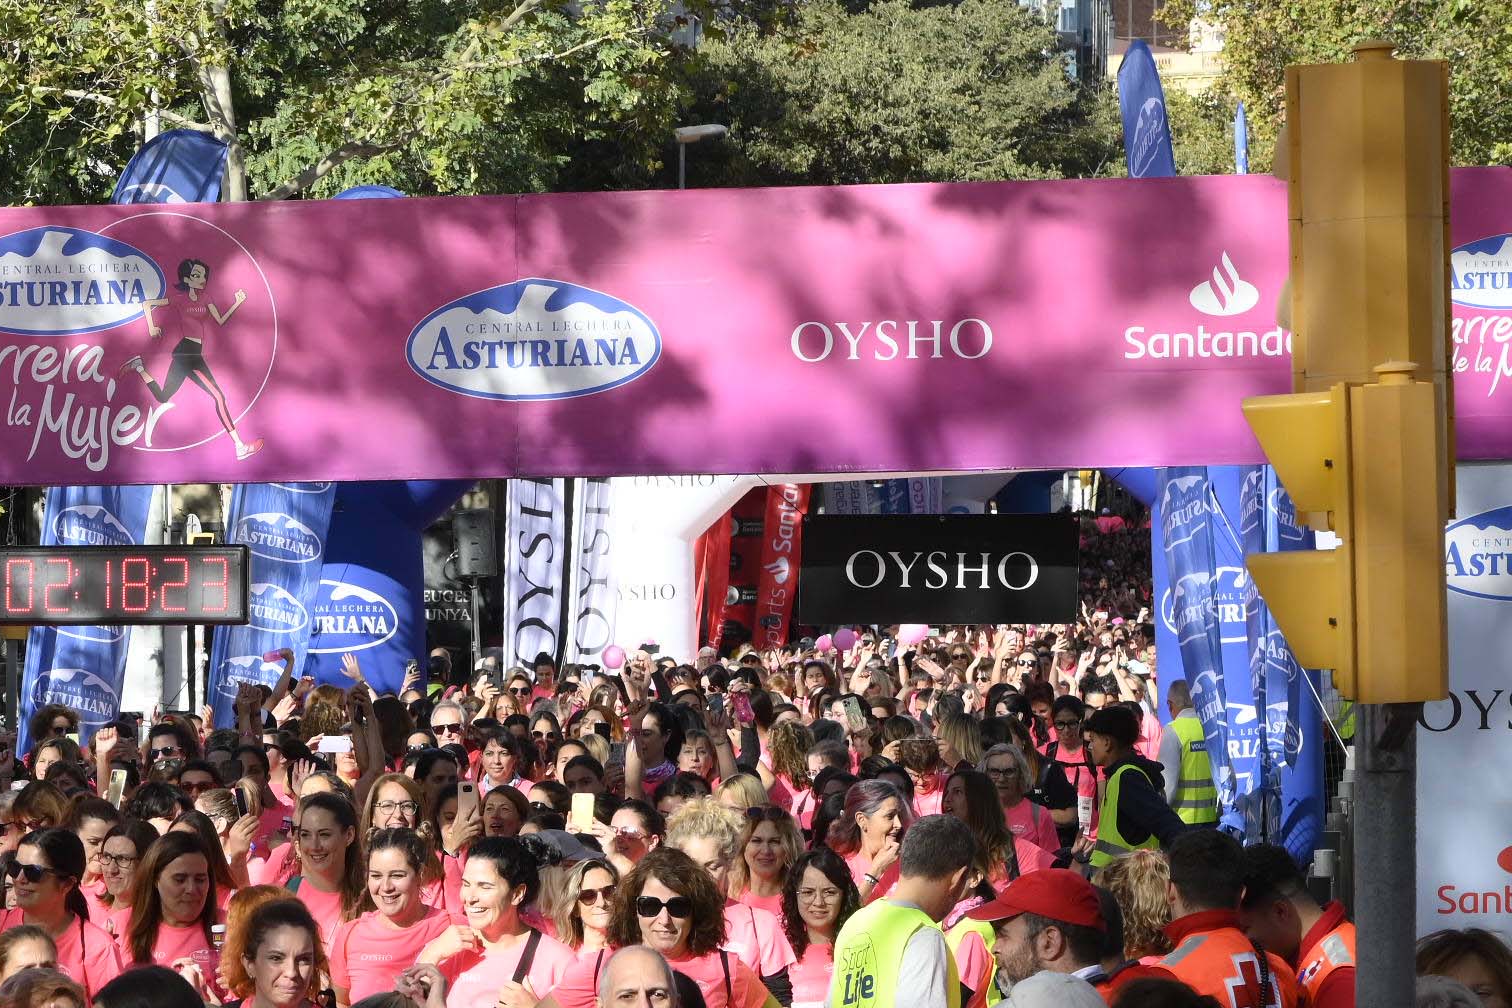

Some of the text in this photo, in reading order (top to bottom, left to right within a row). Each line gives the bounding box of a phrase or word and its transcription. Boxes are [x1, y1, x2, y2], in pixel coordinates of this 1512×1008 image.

[69, 262, 142, 273] LECHERA
[465, 319, 633, 334] CENTRAL LECHERA
[790, 318, 994, 363] OYSHO
[1452, 314, 1512, 345] arre
[425, 326, 642, 370] ASTURIANA
[1474, 344, 1493, 374] la
[7, 389, 32, 427] la
[28, 379, 176, 472] Mujer
[772, 482, 798, 553] Santa
[237, 523, 314, 557] ASTURIANA
[5, 557, 229, 613] 02:18:23
[845, 549, 1040, 591] OYSHO
[335, 604, 385, 613] LECHERA
